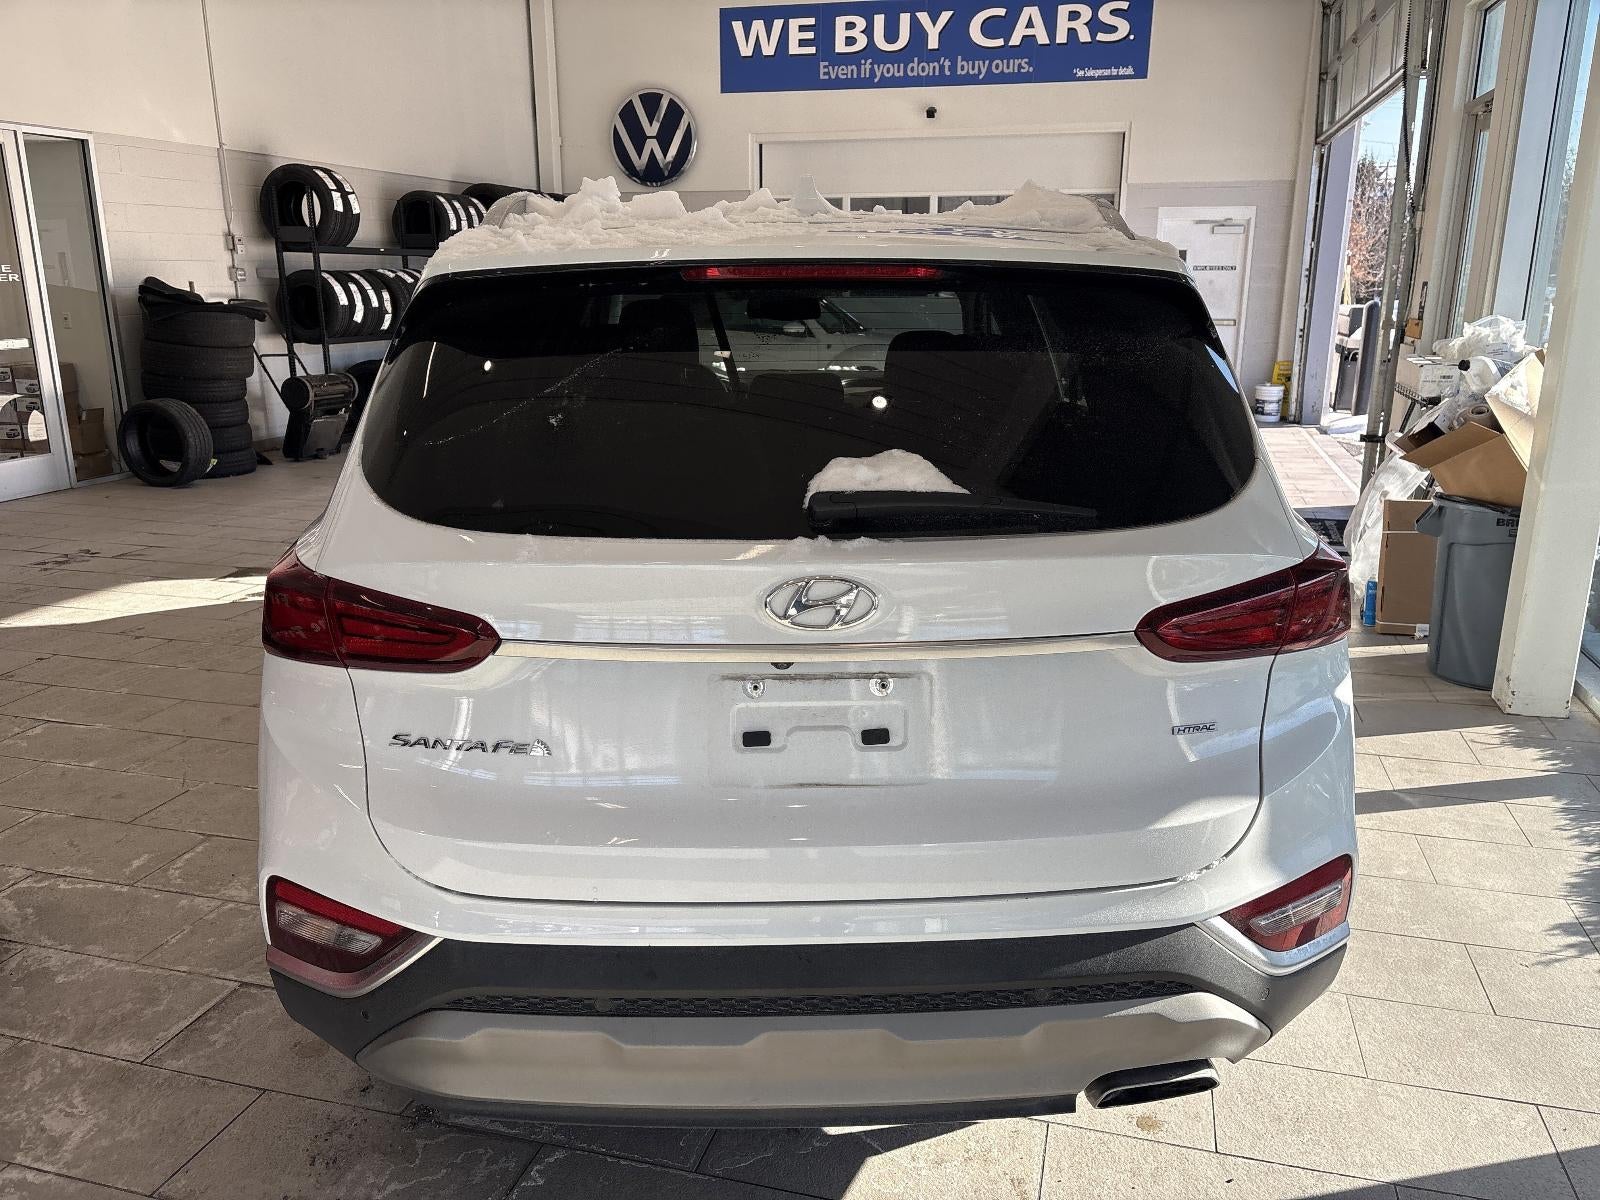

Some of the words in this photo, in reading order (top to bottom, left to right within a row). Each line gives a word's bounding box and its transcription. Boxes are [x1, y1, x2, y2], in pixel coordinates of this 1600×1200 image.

[731, 17, 817, 57] WE
[835, 10, 955, 53] BUY
[969, 1, 1135, 48] CARS.
[820, 61, 857, 79] Even
[861, 59, 872, 78] if
[874, 63, 904, 83] you
[907, 56, 951, 77] don't
[957, 56, 989, 79] buy
[992, 58, 1033, 74] ours.
[1175, 723, 1216, 734] HTRAC
[389, 733, 488, 753] SANTA
